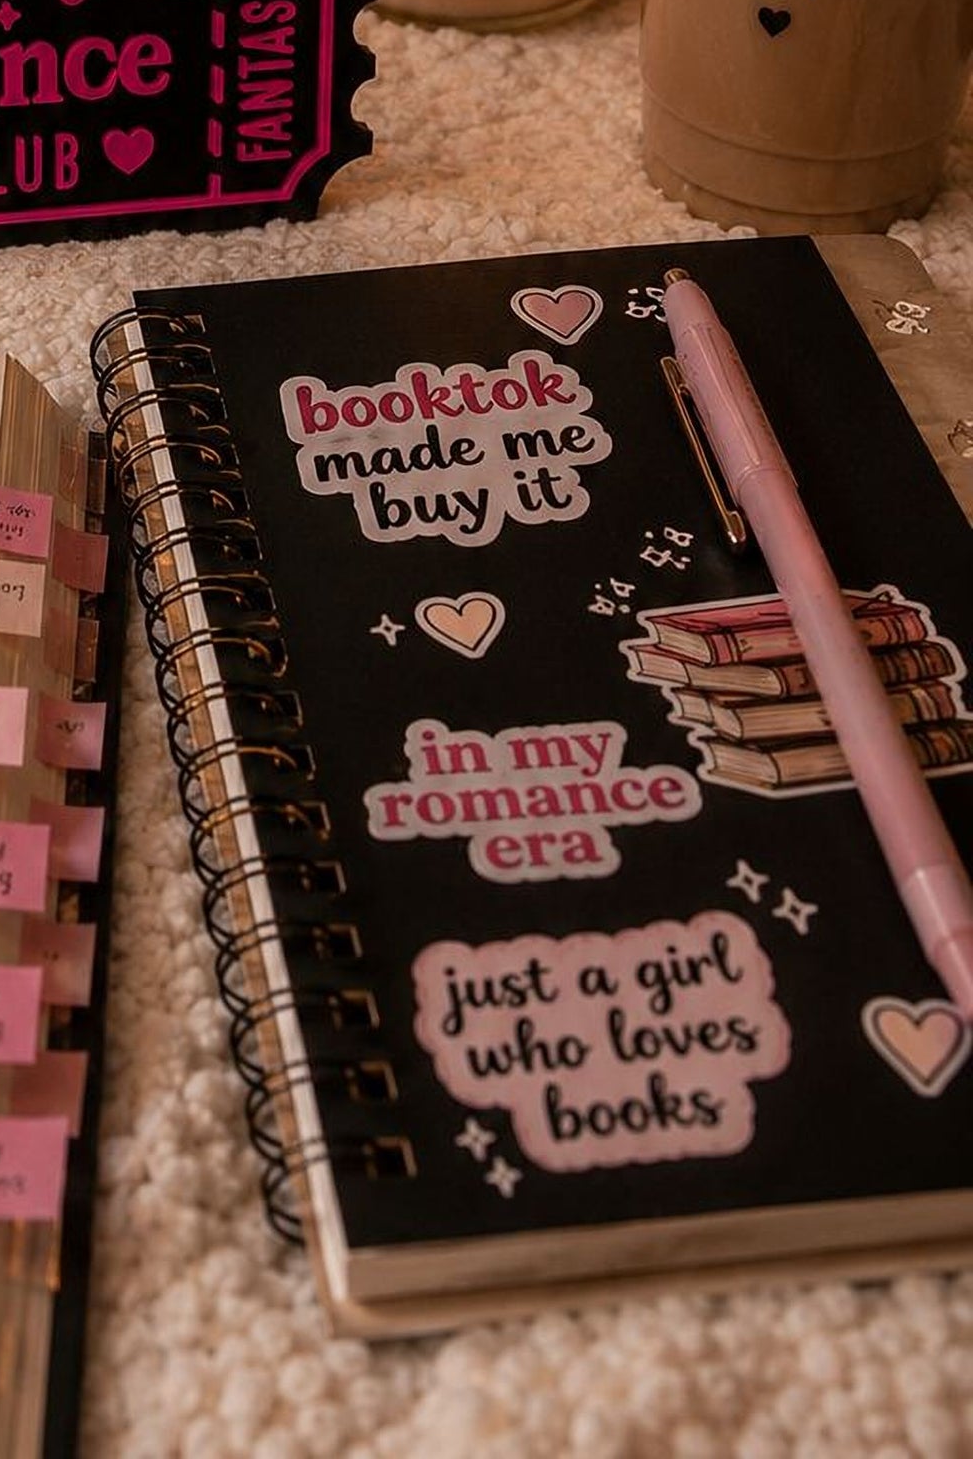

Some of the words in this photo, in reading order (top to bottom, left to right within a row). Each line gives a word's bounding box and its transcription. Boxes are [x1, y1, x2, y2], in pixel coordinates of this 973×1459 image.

[294, 360, 577, 435] booktok
[312, 425, 486, 484] made
[502, 424, 595, 462] me
[368, 481, 489, 534] buy
[514, 467, 574, 513] it
[419, 728, 493, 776] in
[506, 730, 613, 778] my
[379, 773, 688, 830] romance
[483, 826, 605, 870] era
[440, 958, 559, 1037] just
[577, 964, 619, 997] a
[637, 932, 745, 1014] girl
[466, 1005, 592, 1080] who
[607, 1012, 761, 1066] loves
[544, 1075, 726, 1143] books
